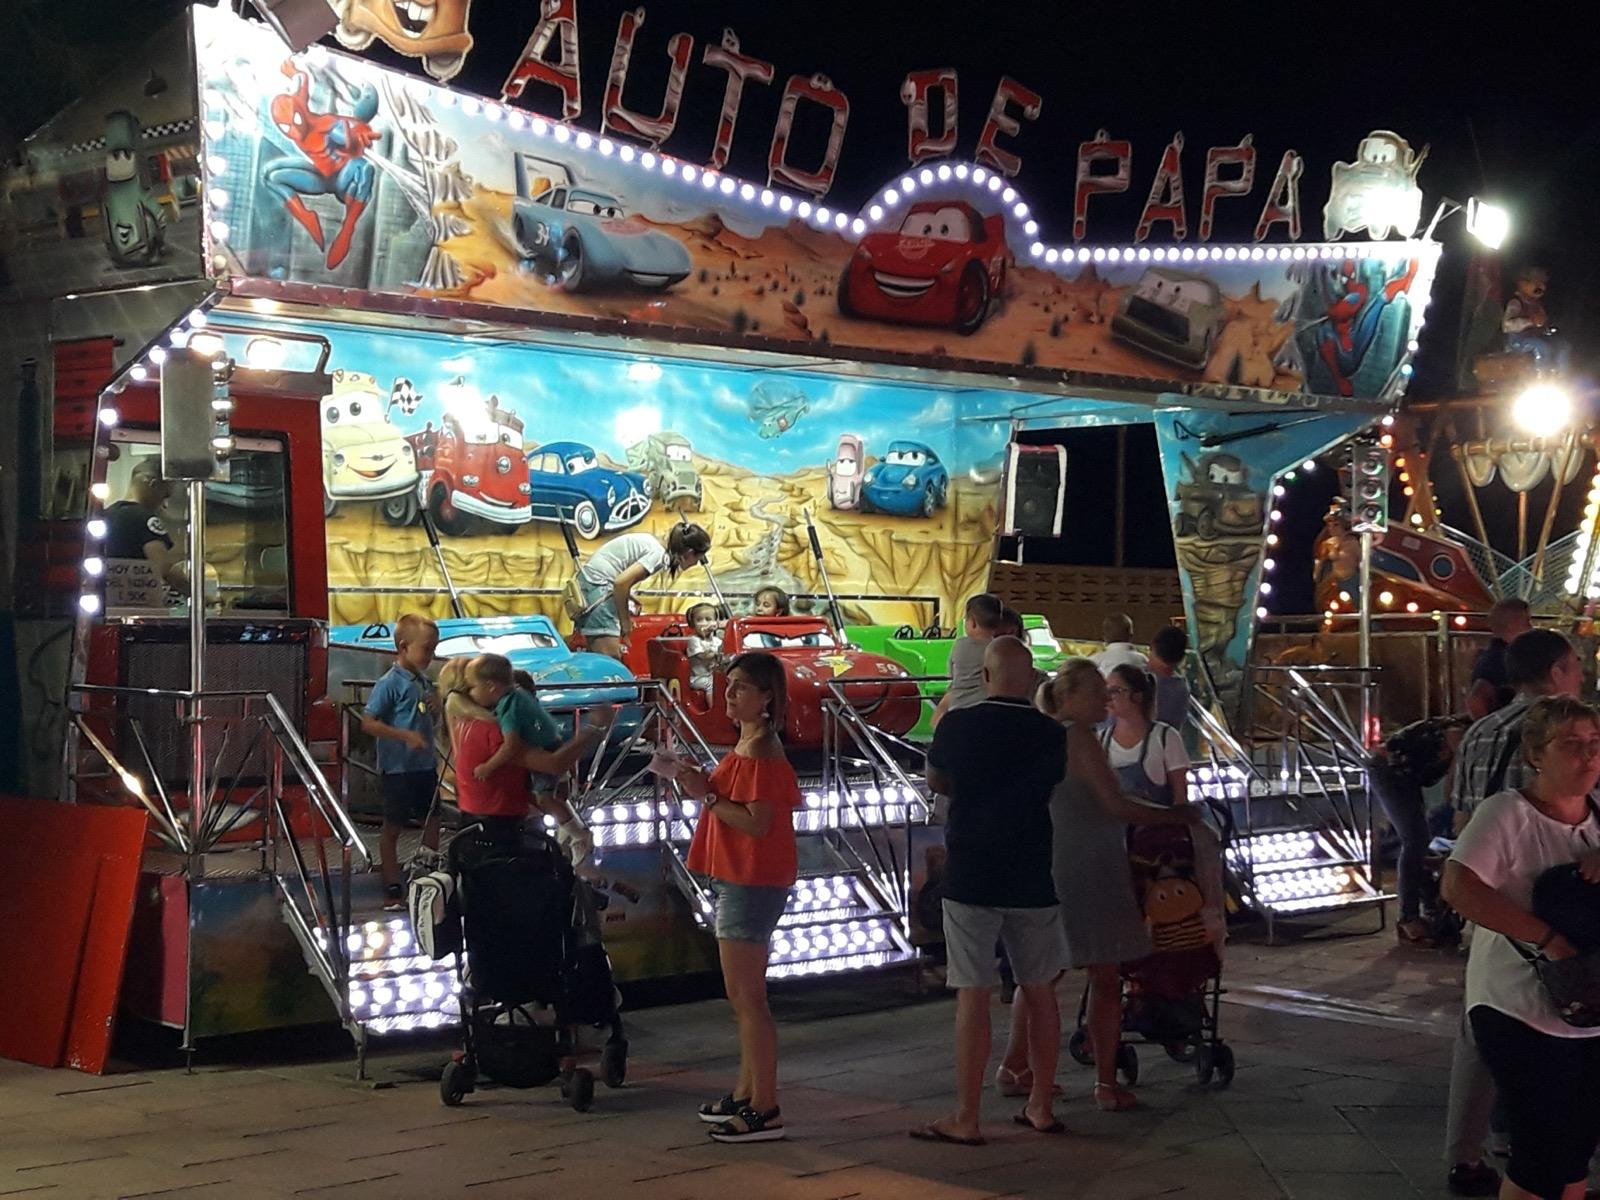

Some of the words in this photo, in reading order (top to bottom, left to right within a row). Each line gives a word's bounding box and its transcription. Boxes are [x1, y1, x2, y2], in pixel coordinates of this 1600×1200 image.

[501, 0, 850, 200] AUTO
[900, 67, 1042, 177] DE
[1073, 129, 1303, 242] PAPA
[875, 662, 898, 675] 59
